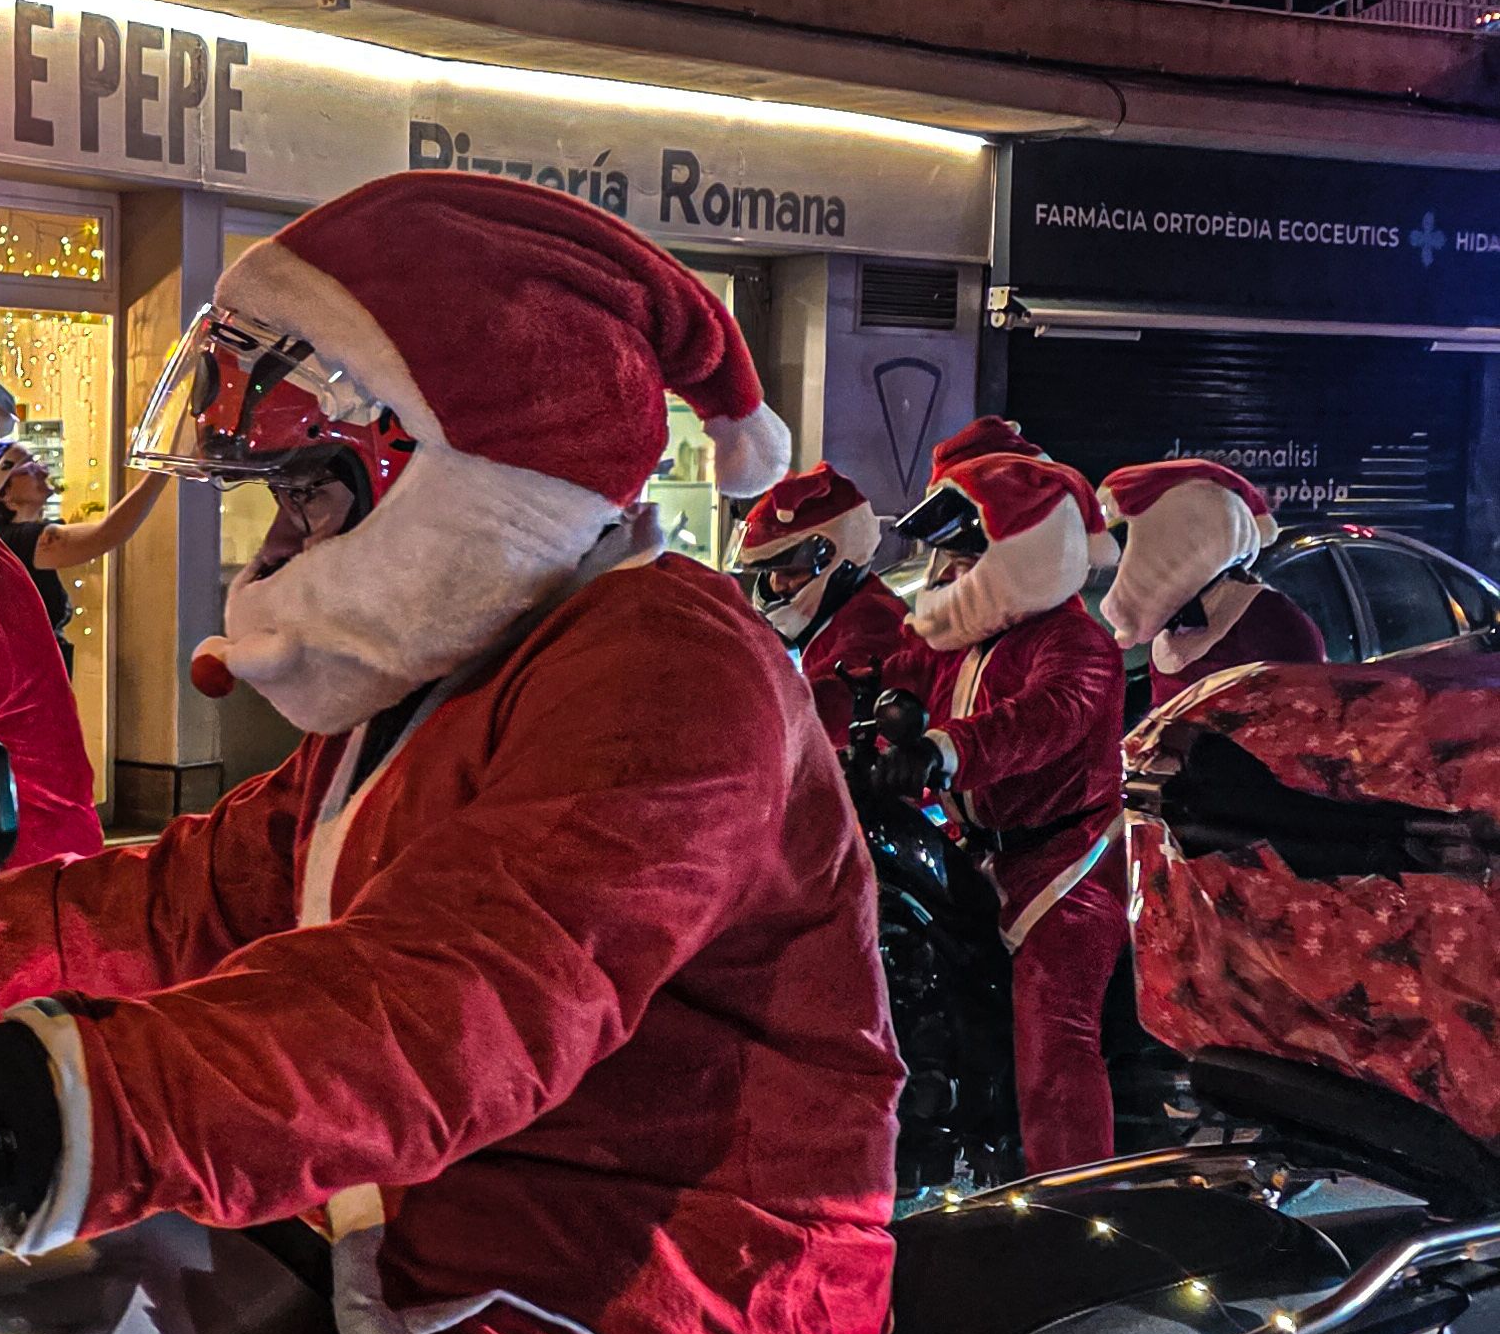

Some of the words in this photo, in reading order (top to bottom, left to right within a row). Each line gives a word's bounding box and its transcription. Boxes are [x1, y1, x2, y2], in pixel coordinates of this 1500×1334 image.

[80, 11, 248, 174] PEPE
[660, 148, 846, 238] Romana
[1034, 201, 1147, 231] FARMÀCIA
[1153, 211, 1272, 240] ORTOPÈDIA
[1278, 220, 1400, 248] ECOCEUTICS
[1274, 478, 1349, 510] pròpia
